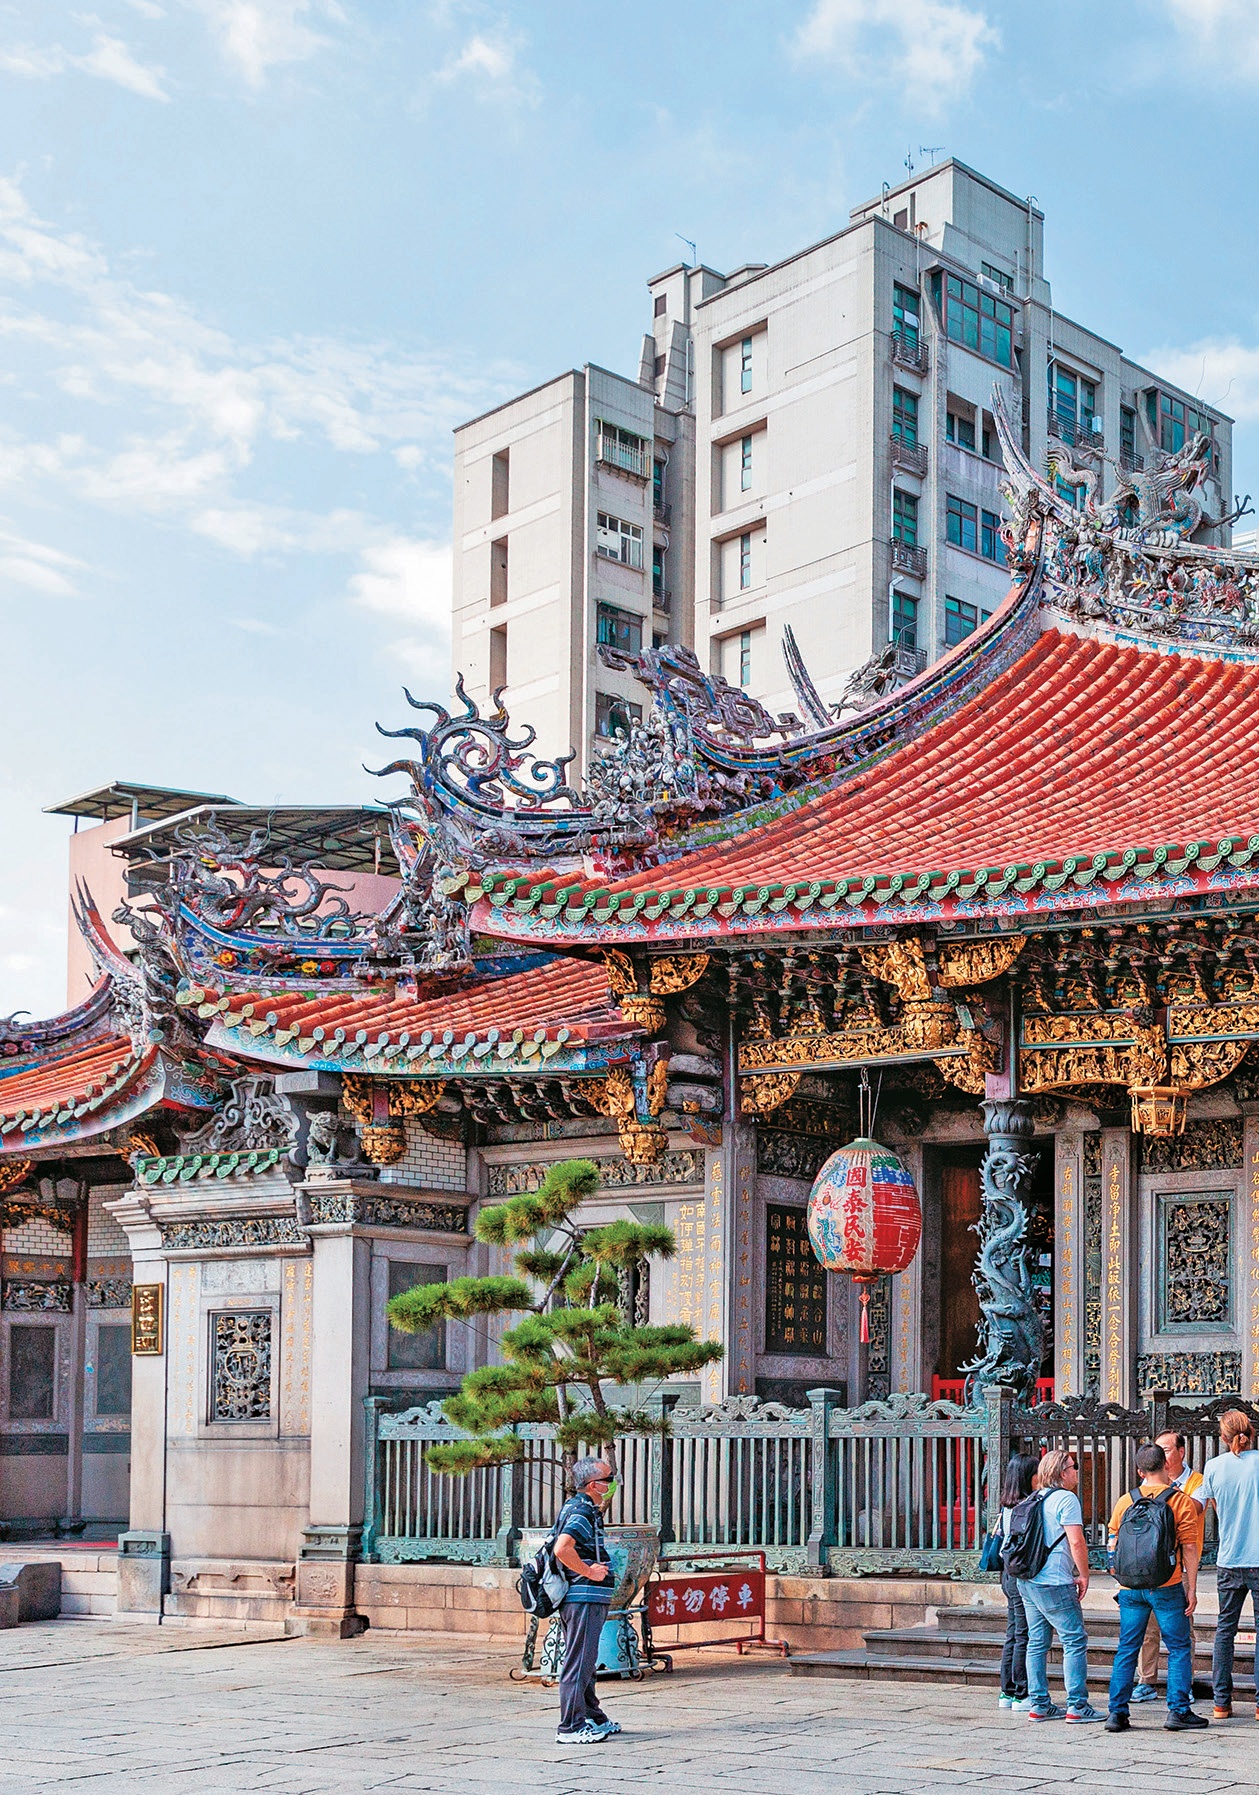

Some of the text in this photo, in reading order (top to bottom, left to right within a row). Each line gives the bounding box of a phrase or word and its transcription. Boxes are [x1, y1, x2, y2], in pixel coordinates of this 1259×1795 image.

[842, 1166, 868, 1263] 國泰民安
[655, 1583, 753, 1615] 請勿停車
